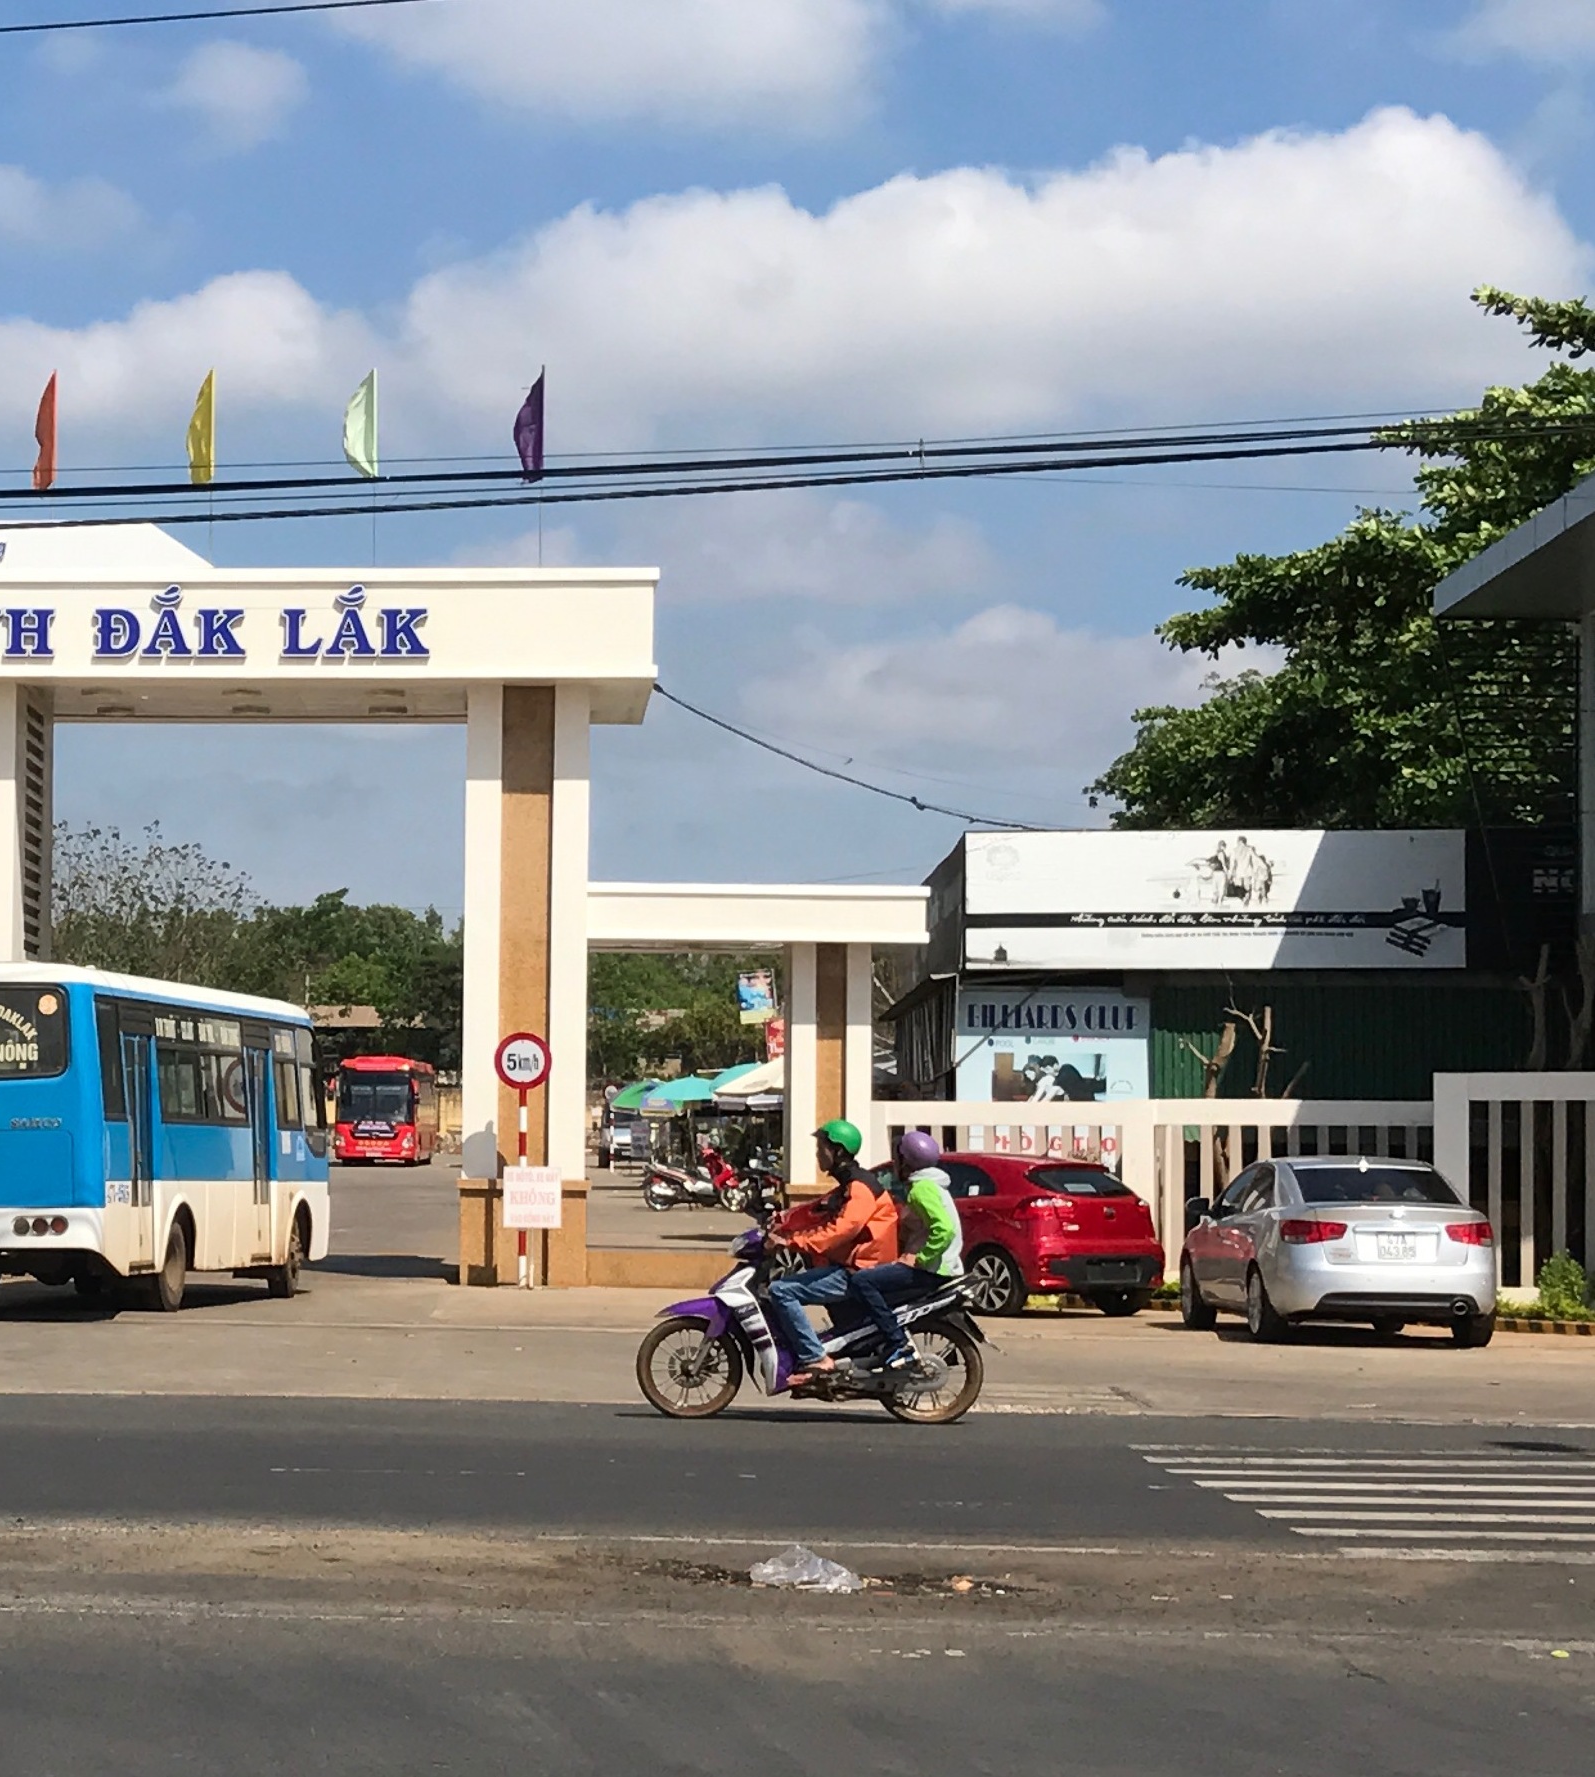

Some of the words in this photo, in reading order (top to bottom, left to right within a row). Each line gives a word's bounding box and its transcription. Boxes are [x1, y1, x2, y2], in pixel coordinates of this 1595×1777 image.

[93, 584, 245, 658] ĐẮK
[281, 584, 430, 658] LẮK
[967, 1004, 1078, 1030] BILLIARDS
